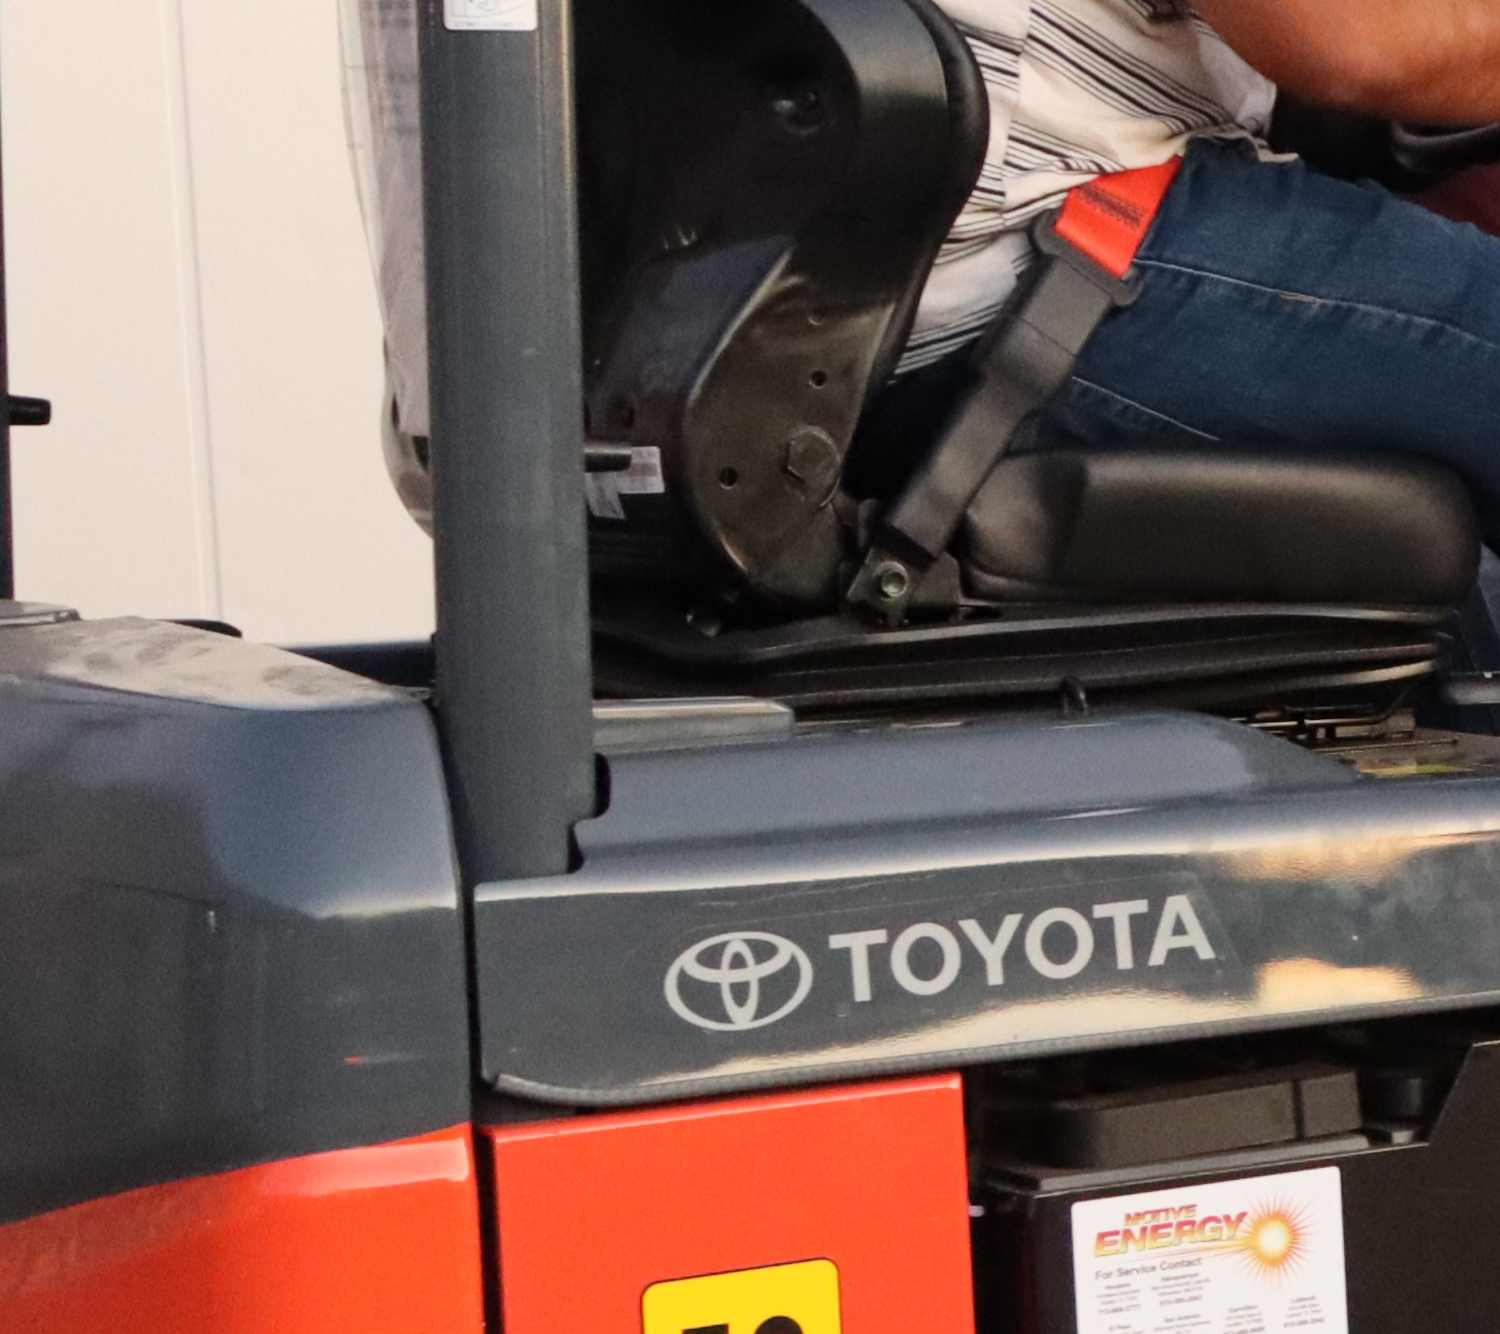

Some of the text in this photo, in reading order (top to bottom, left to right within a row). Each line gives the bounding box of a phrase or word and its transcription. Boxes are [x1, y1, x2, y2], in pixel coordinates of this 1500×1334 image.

[828, 893, 1216, 1004] TOYOTA
[1123, 1204, 1198, 1227] MOTIVE
[1093, 1211, 1249, 1258] ENERGY
[1095, 1256, 1203, 1281] For Service Contact
